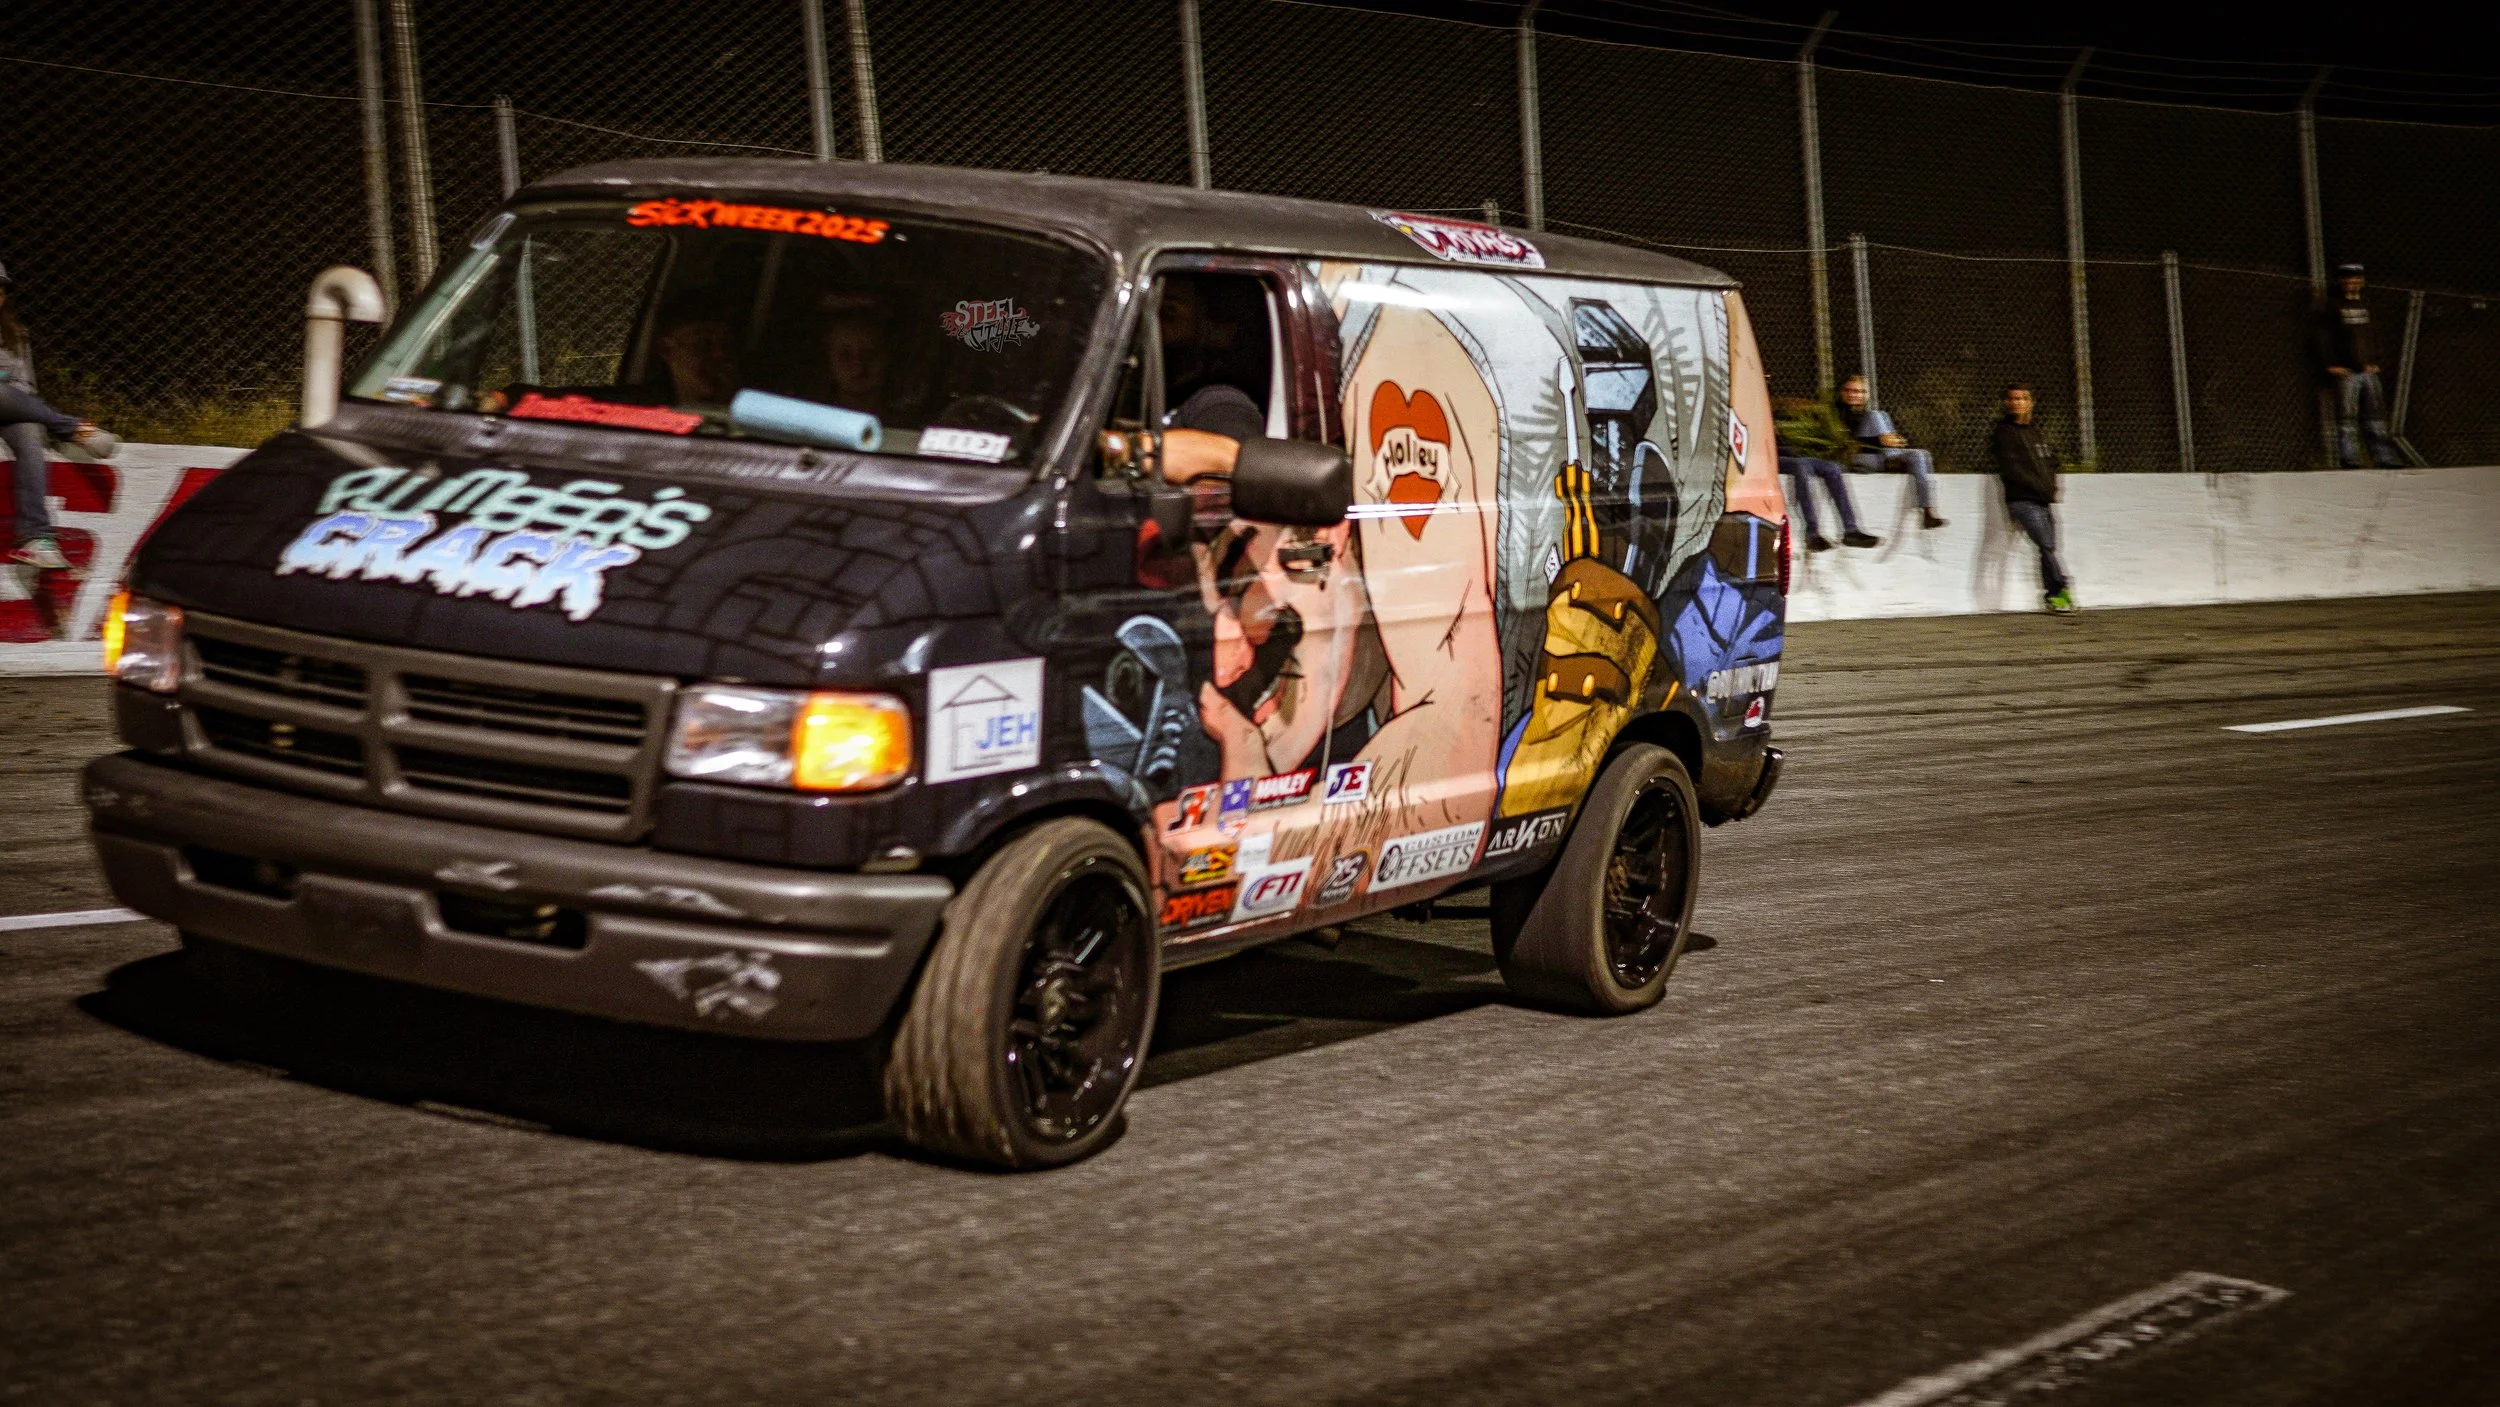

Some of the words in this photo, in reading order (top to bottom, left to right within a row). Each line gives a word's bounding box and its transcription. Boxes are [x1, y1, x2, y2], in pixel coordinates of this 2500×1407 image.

[954, 297, 1024, 326] STEEL
[1382, 433, 1438, 479] Holley
[275, 510, 642, 622] CRACK
[975, 711, 1038, 750] JEH
